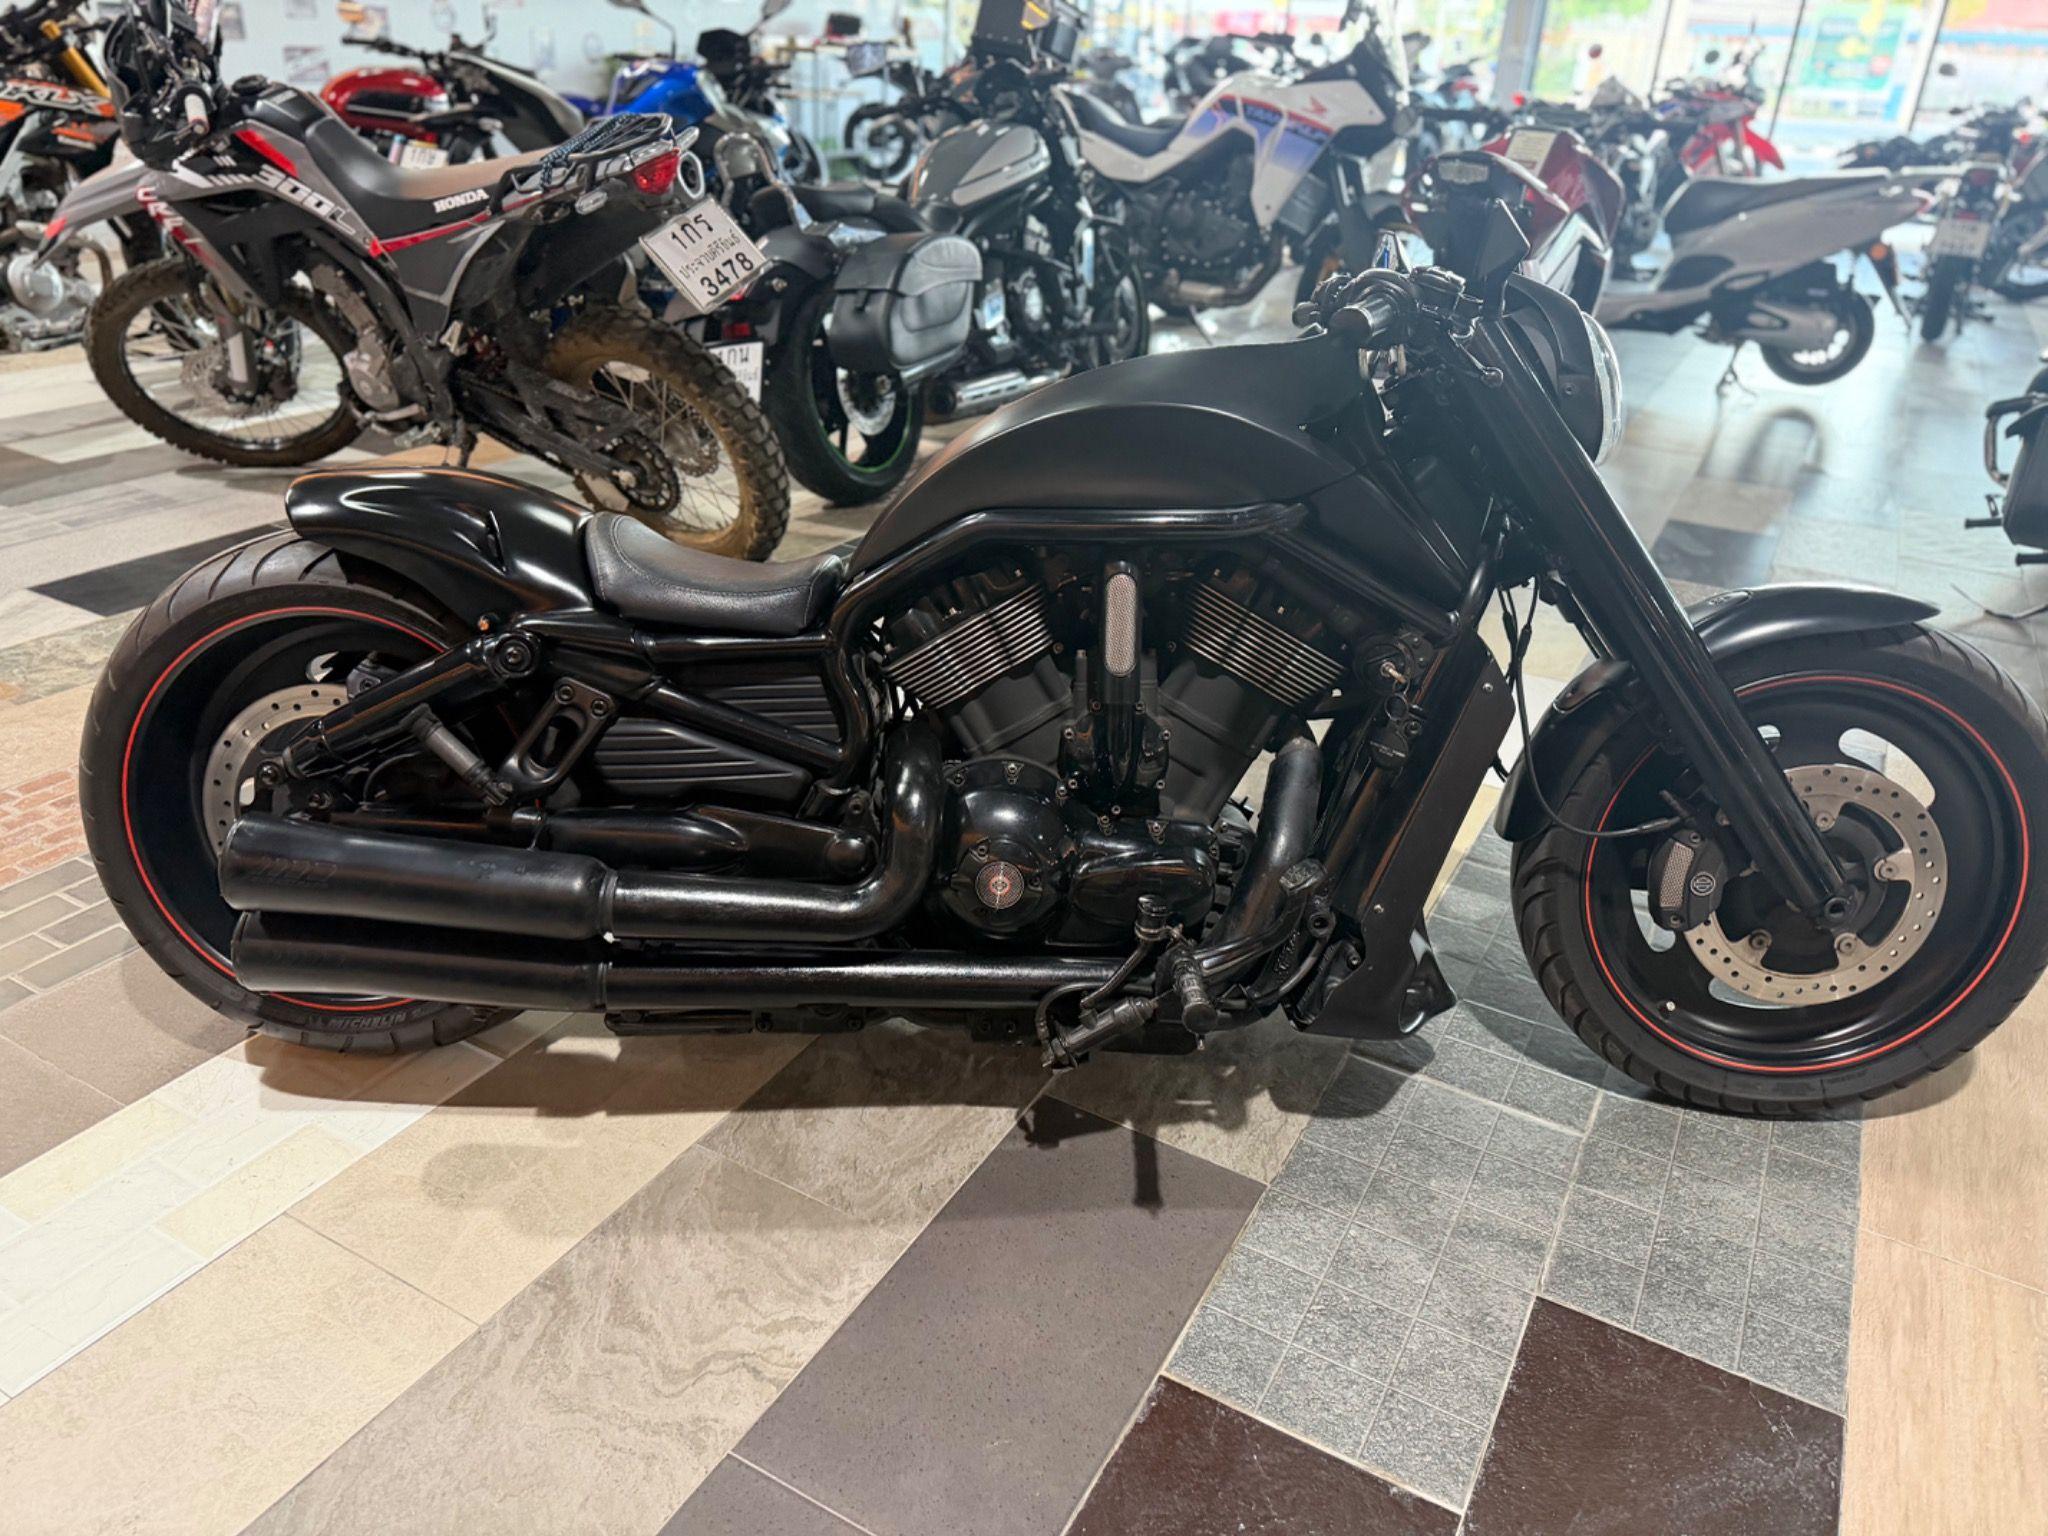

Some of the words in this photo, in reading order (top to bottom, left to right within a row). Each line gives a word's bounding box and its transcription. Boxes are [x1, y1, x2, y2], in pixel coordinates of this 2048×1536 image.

[252, 163, 356, 236] 300L
[433, 188, 490, 214] HONDA
[671, 213, 714, 250] 1กร
[700, 252, 754, 297] 3478
[328, 1011, 407, 1030] MICHELIN
